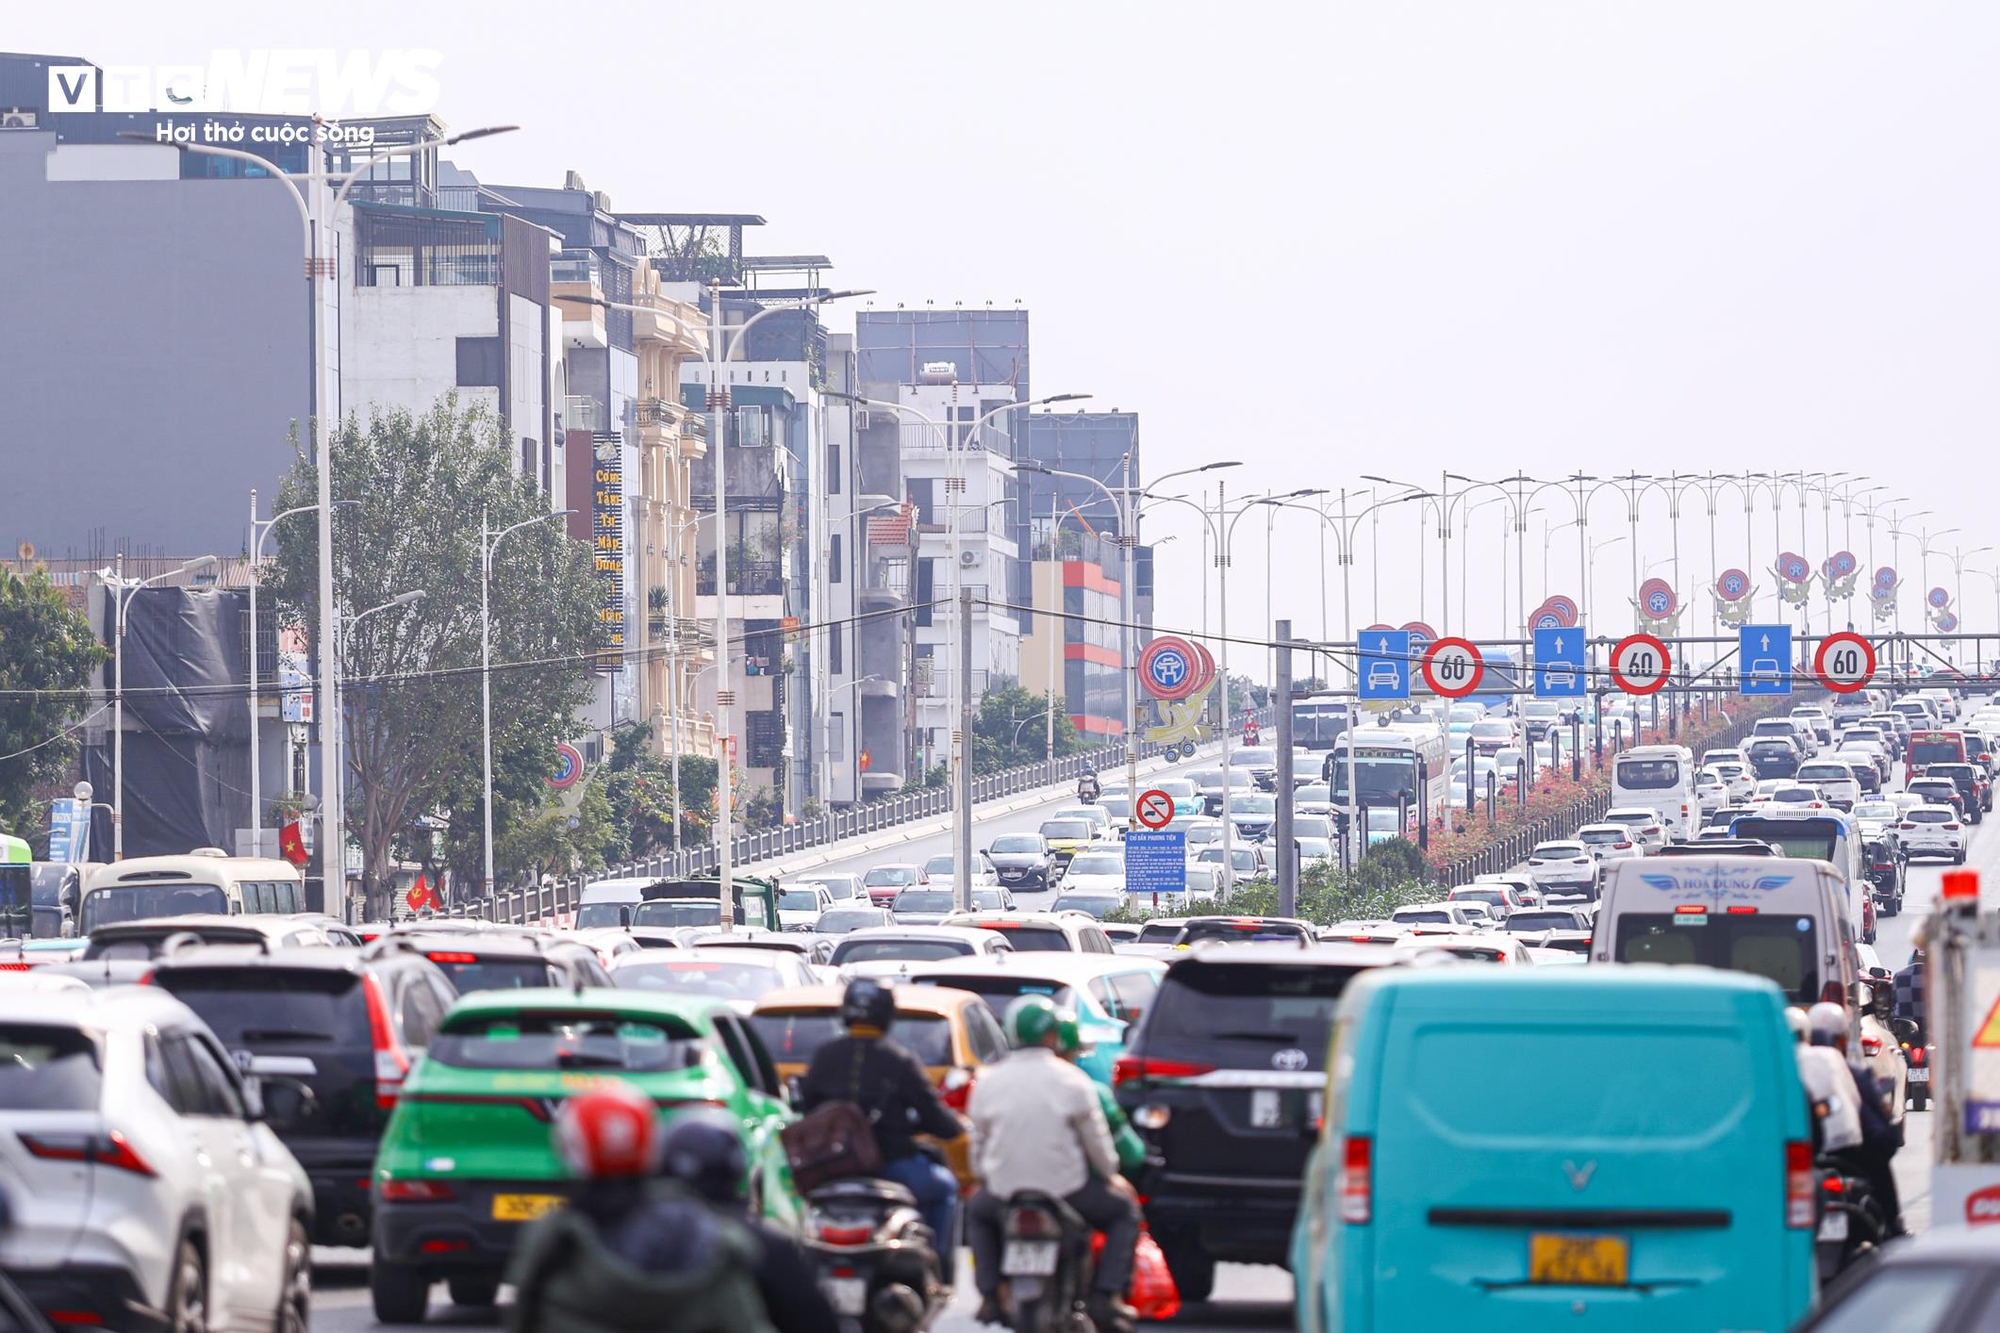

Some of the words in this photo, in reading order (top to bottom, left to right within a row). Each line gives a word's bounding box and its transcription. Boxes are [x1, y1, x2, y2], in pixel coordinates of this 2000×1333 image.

[1441, 655, 1465, 680] 60
[1629, 652, 1652, 677] 60
[1833, 650, 1857, 674] 60
